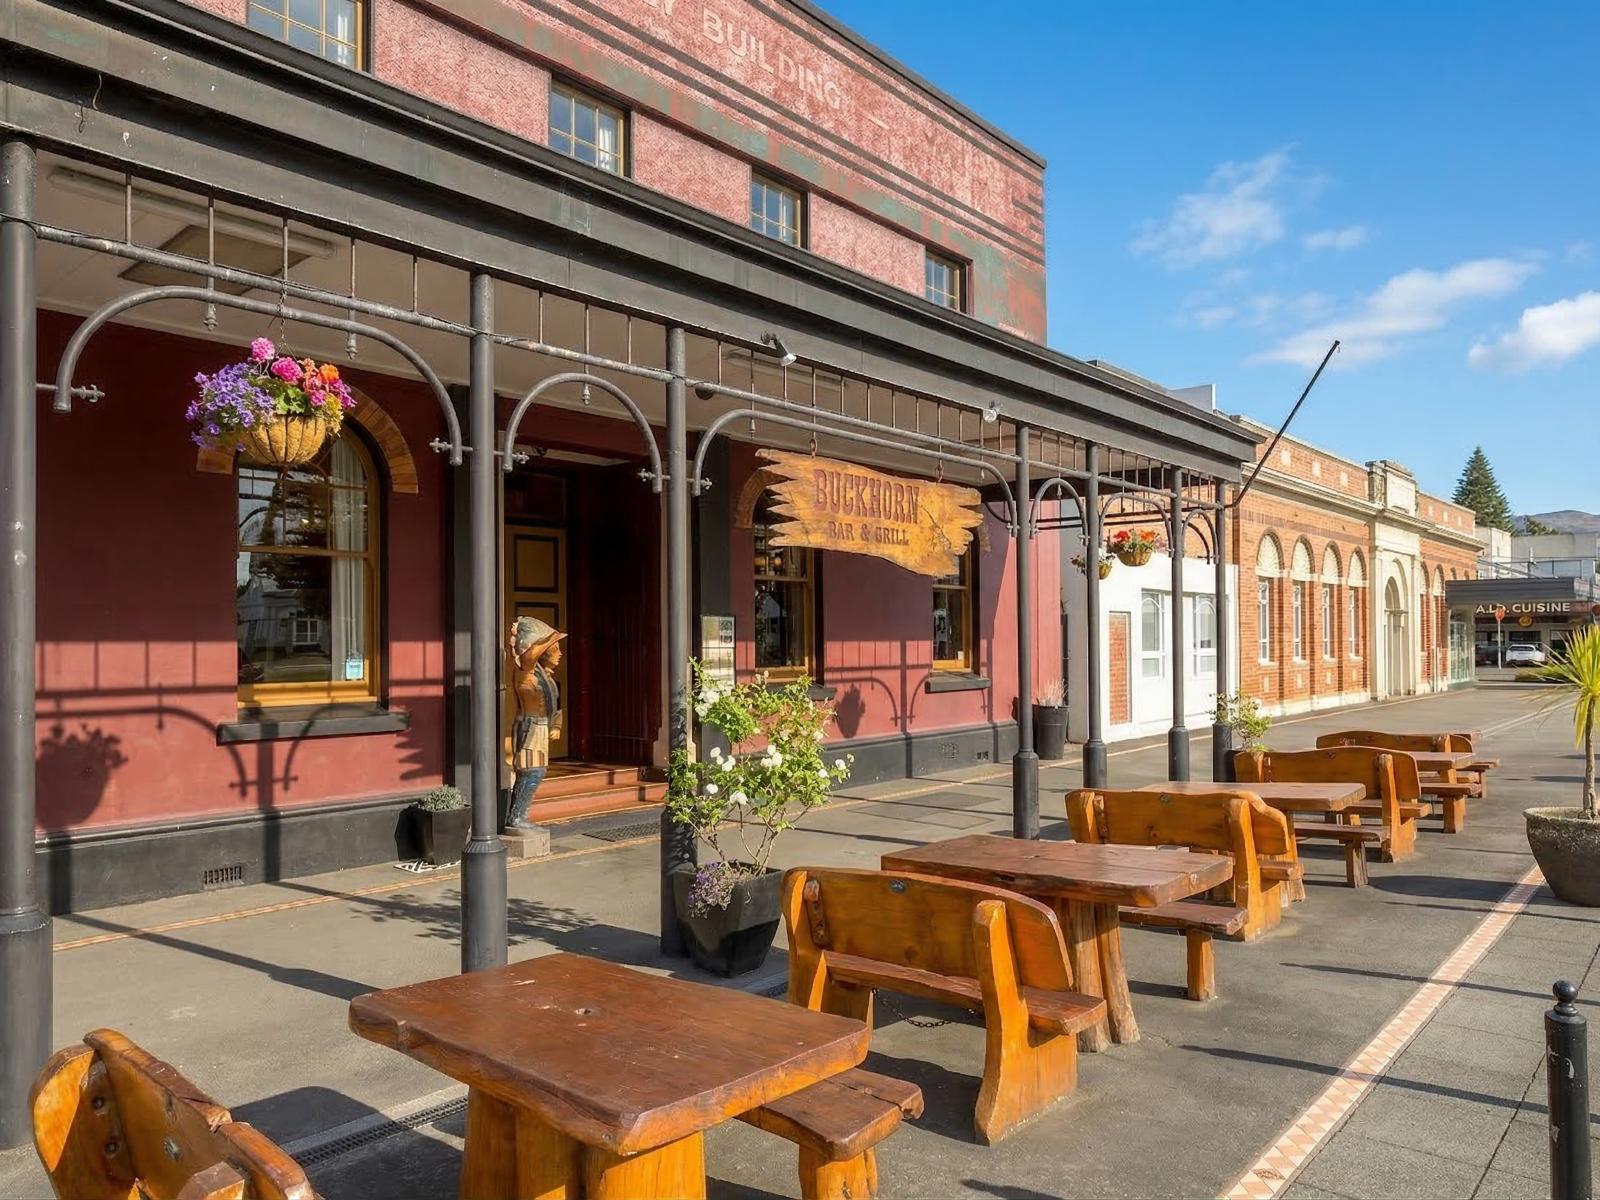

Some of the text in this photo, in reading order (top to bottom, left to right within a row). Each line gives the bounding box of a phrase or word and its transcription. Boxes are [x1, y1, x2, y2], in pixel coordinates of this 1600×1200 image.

[703, 9, 841, 109] BUILDING
[814, 469, 920, 524] BUCKHORN
[829, 521, 909, 545] BAR & GRILL
[1512, 602, 1571, 613] CUISINE
